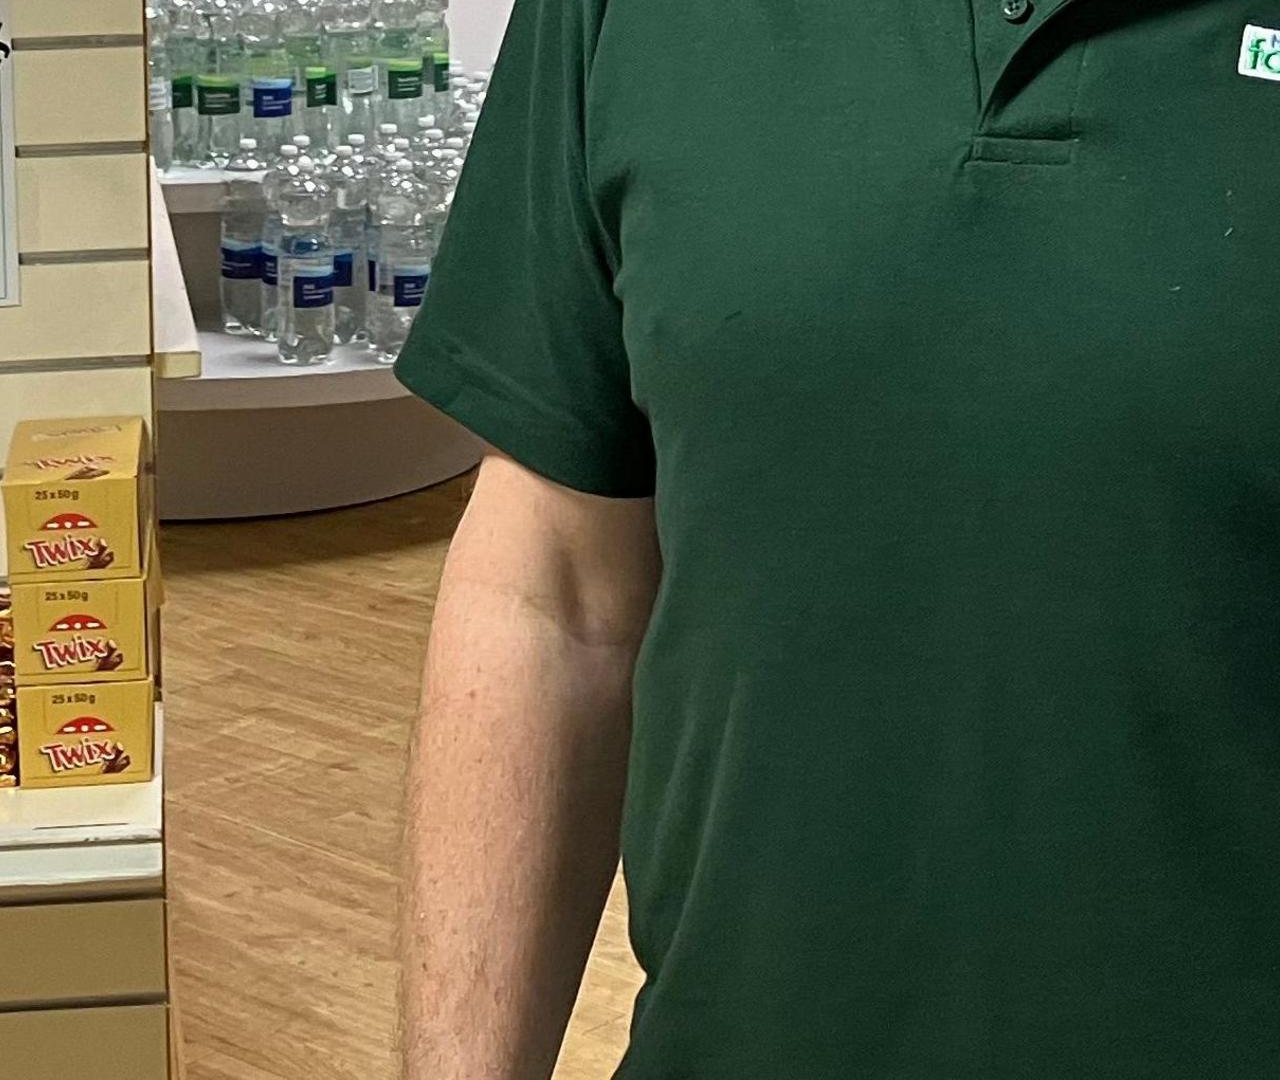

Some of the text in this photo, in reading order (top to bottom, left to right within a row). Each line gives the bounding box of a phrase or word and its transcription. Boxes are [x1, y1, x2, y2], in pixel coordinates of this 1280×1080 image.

[24, 533, 99, 570] Twix
[34, 635, 110, 670] Twix
[41, 736, 116, 773] Twix
